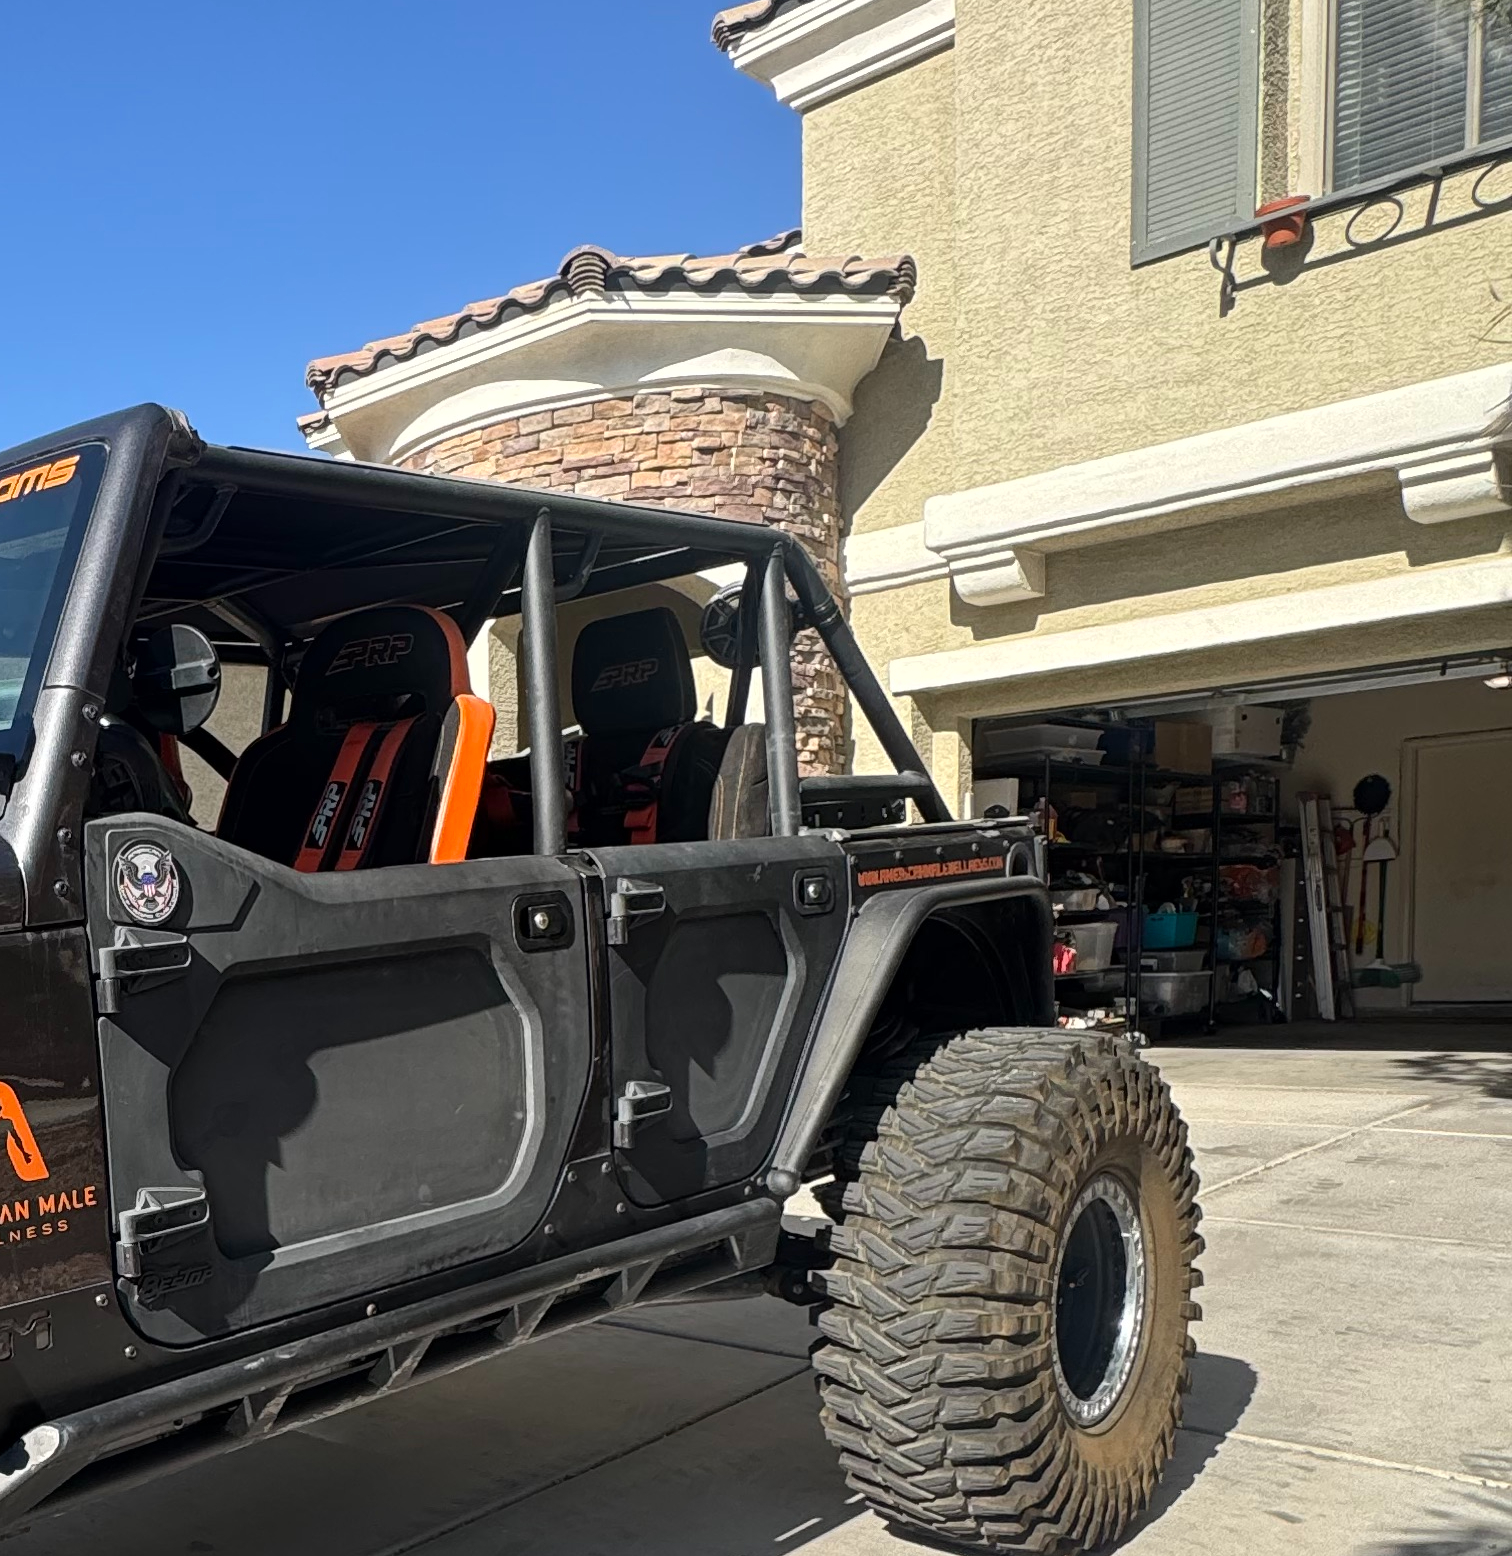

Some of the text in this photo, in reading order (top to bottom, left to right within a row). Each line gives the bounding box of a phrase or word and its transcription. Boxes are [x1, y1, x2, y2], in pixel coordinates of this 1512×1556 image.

[325, 633, 414, 676] PRP
[312, 782, 341, 847] PRP
[38, 1185, 98, 1213] MALE
